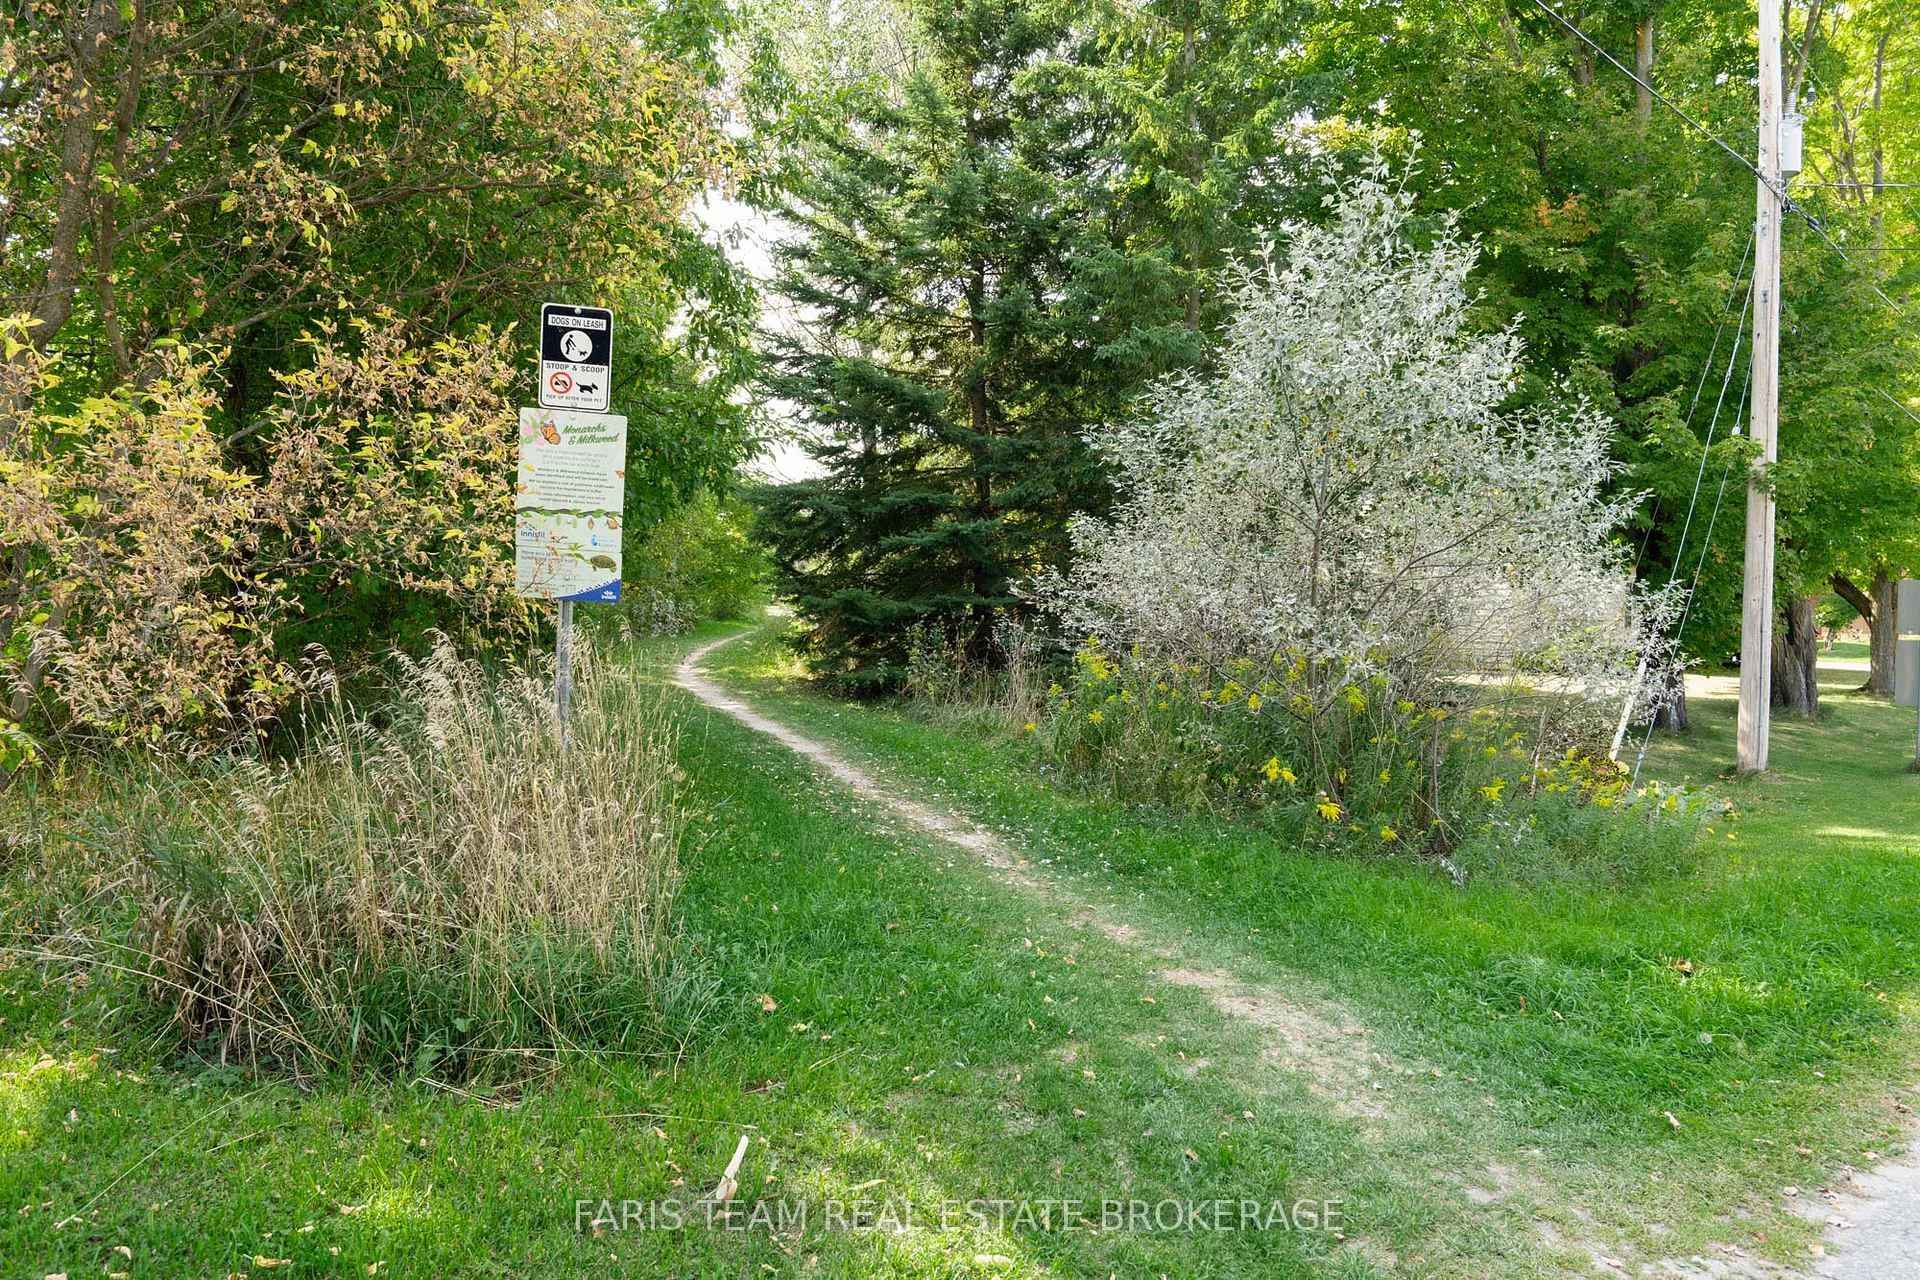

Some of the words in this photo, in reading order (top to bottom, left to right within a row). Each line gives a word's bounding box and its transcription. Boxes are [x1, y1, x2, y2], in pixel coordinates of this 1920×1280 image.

[551, 316, 570, 326] DOGS
[571, 318, 582, 327] ON
[583, 319, 604, 329] LEASH
[546, 362, 570, 371] STOOP
[581, 365, 605, 374] SCOOP
[562, 422, 607, 433] Monarchs
[568, 435, 576, 445] &
[577, 432, 620, 444] Milkweed
